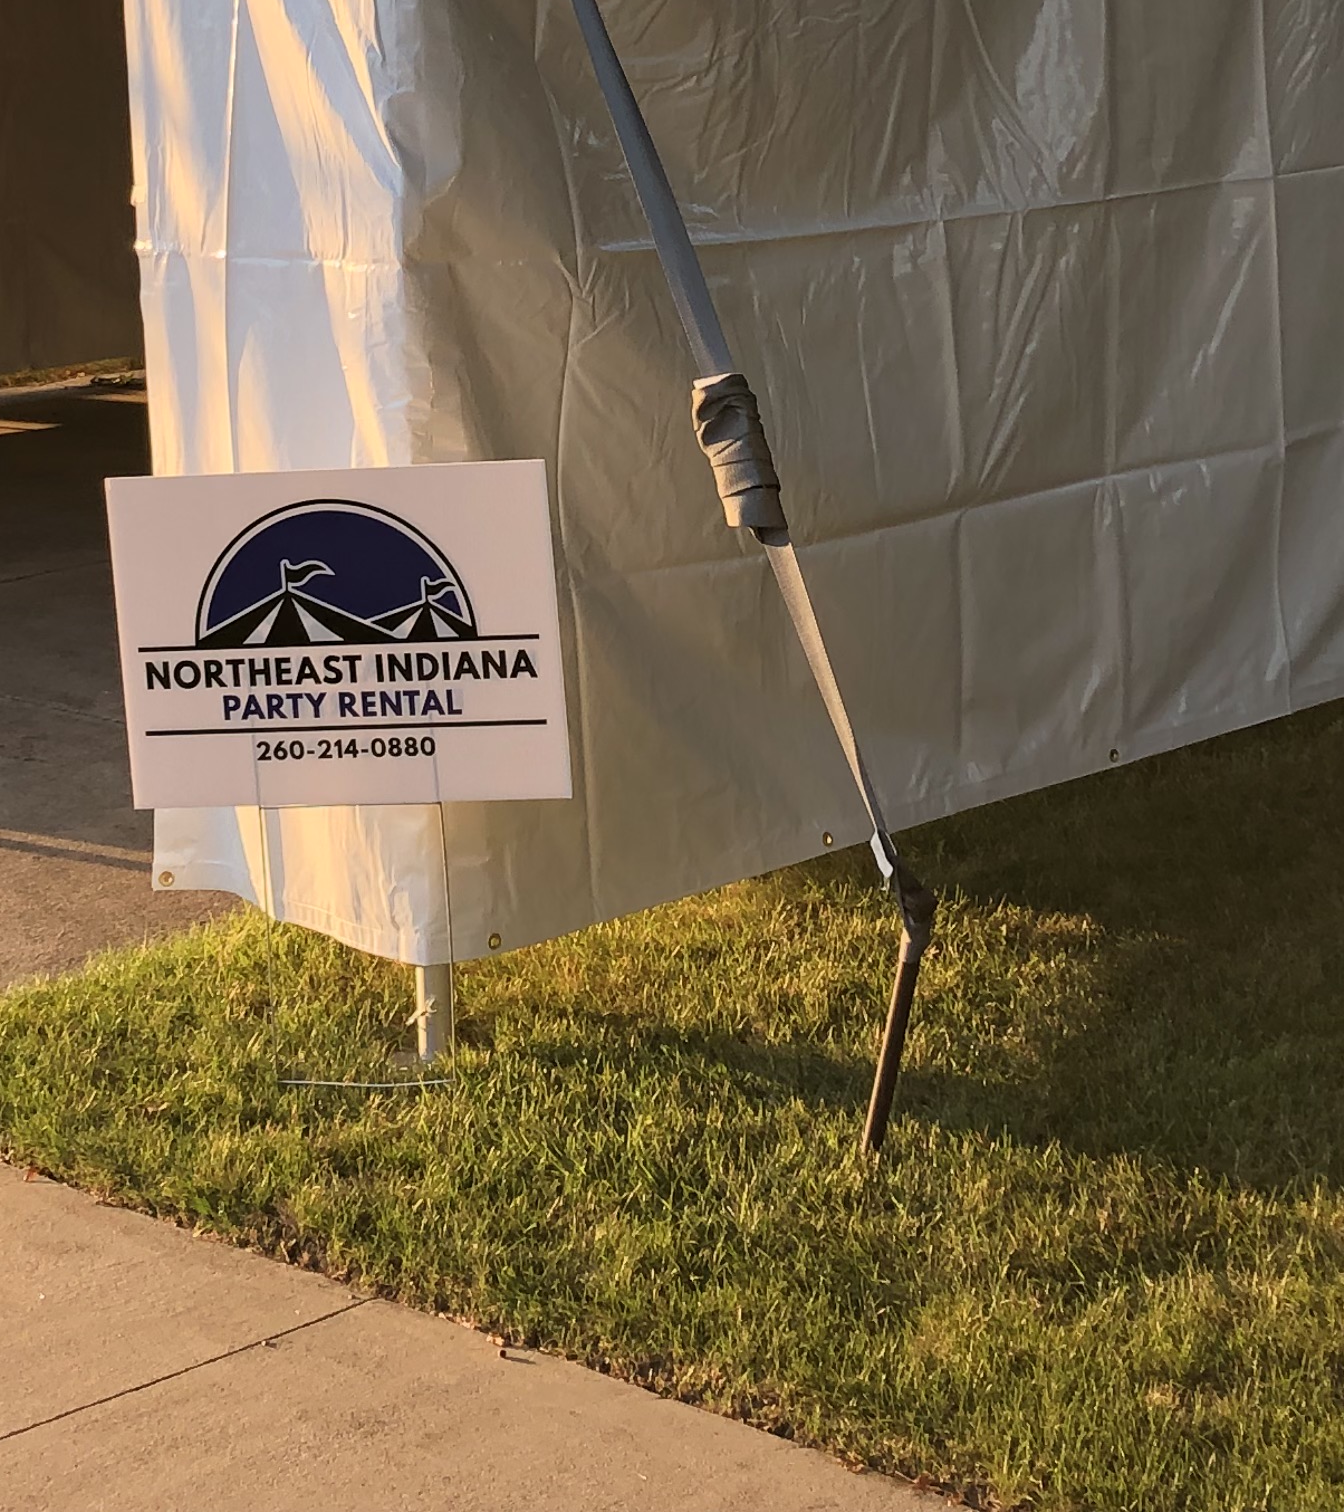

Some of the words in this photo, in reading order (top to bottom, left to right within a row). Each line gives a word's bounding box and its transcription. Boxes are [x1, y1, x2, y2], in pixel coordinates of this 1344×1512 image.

[144, 654, 362, 691] NORTHEAST
[374, 649, 539, 683] INDIANA
[222, 691, 327, 722] PARTY
[338, 688, 464, 719] RENTAL
[256, 736, 437, 762] 260-214-0880
